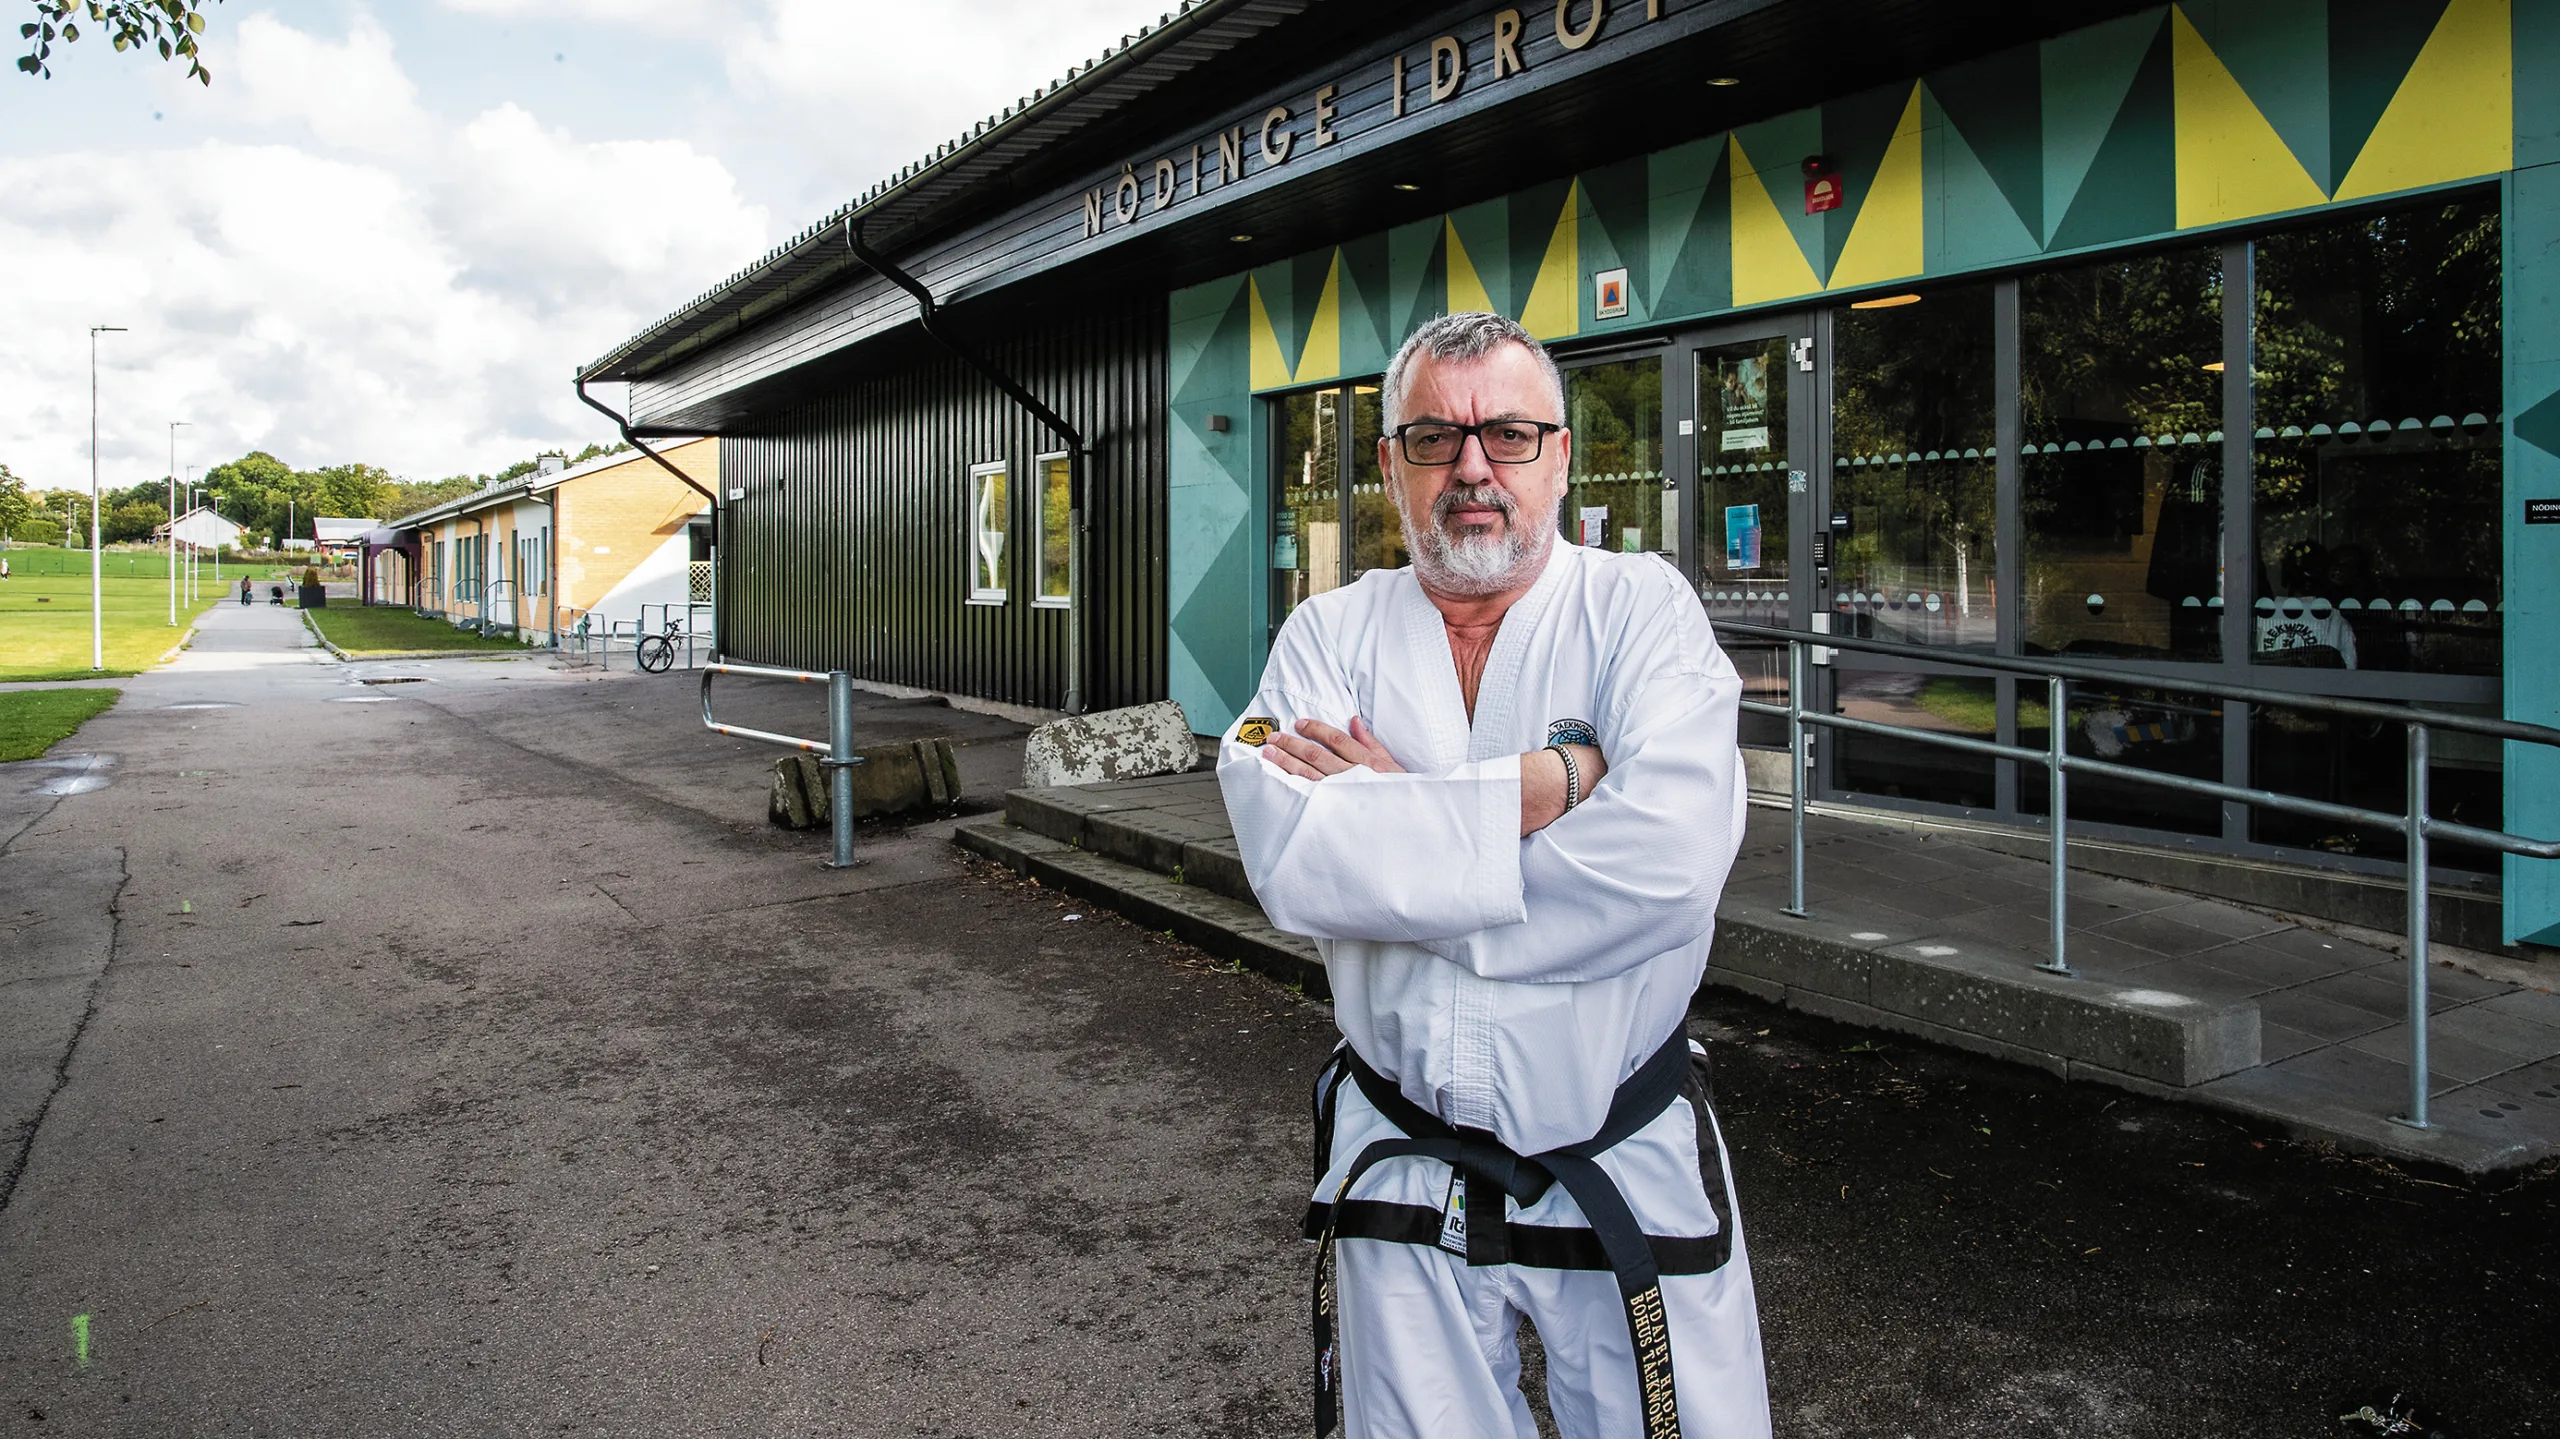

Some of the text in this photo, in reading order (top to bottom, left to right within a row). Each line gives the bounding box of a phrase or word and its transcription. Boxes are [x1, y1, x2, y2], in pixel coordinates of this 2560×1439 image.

[1083, 0, 1659, 238] NÖDINGE IDRO
[1630, 1293, 1653, 1348] BOHUS
[1645, 1286, 1668, 1366] HIDAJET
